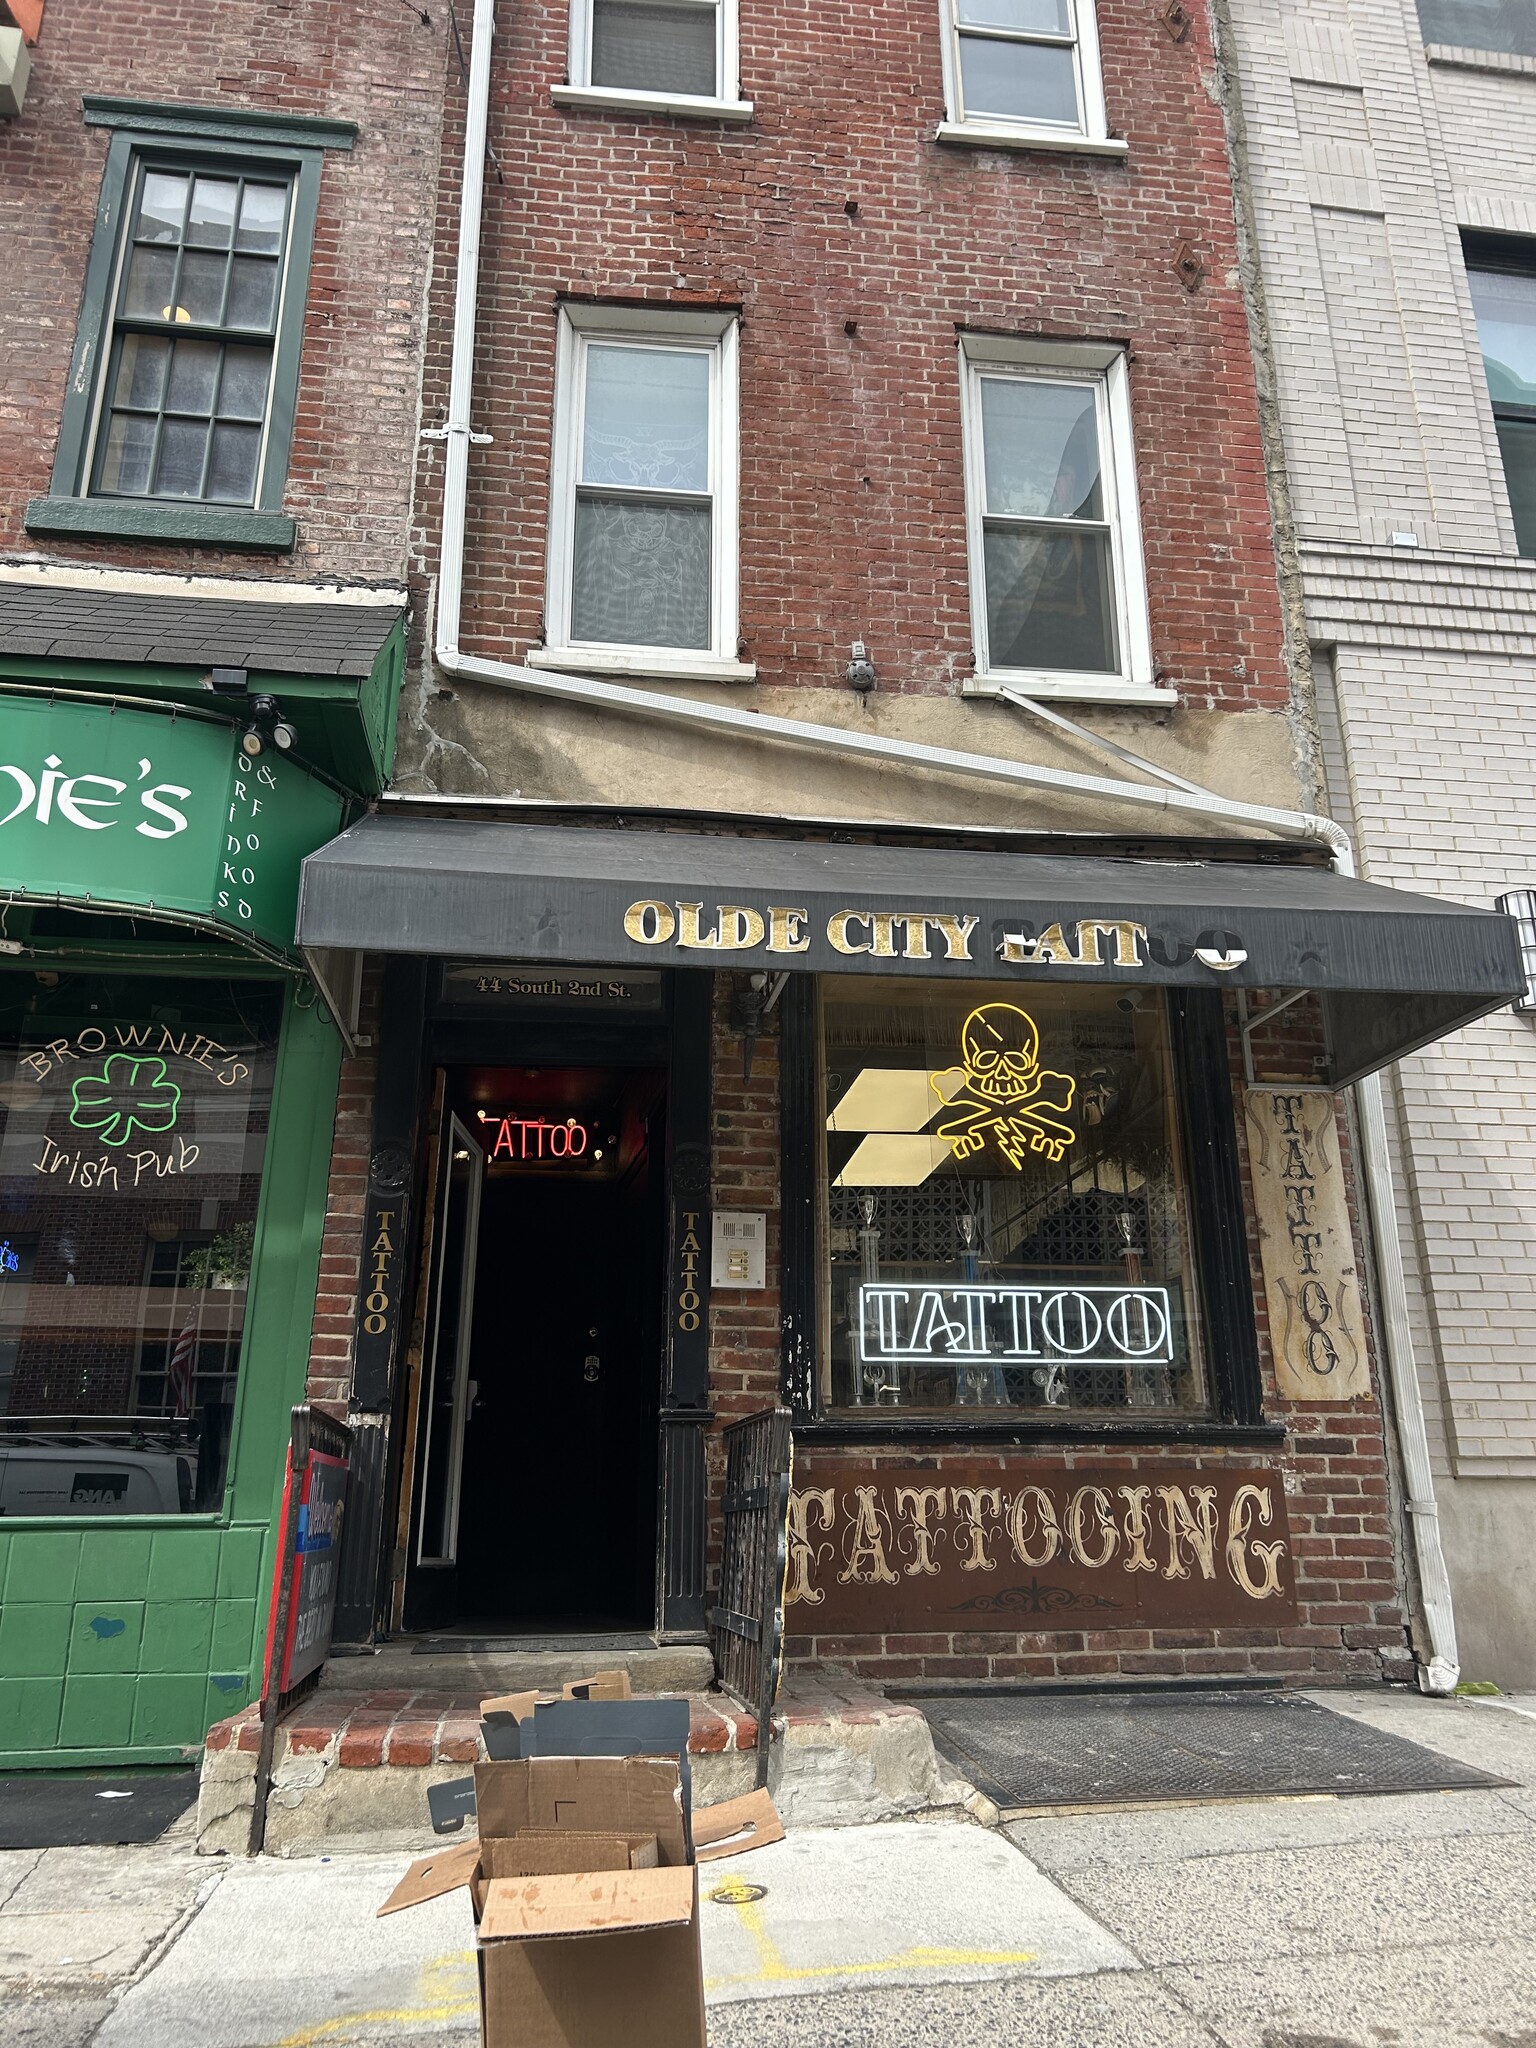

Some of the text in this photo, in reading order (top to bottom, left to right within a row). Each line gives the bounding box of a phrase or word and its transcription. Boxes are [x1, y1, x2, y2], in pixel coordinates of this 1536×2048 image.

[624, 900, 811, 953] OLDE
[826, 909, 980, 960] CITY
[476, 976, 632, 998] 44 South 2nd St.
[20, 1024, 249, 1087] BROWNIE'S
[33, 1135, 200, 1191] Irish Pub
[1271, 1094, 1341, 1376] TATTOO
[364, 1210, 395, 1335] TATTOO
[678, 1212, 701, 1331] TATTOO
[866, 1291, 1167, 1356] TATTOO
[785, 1484, 1288, 1606] TATTOOING
